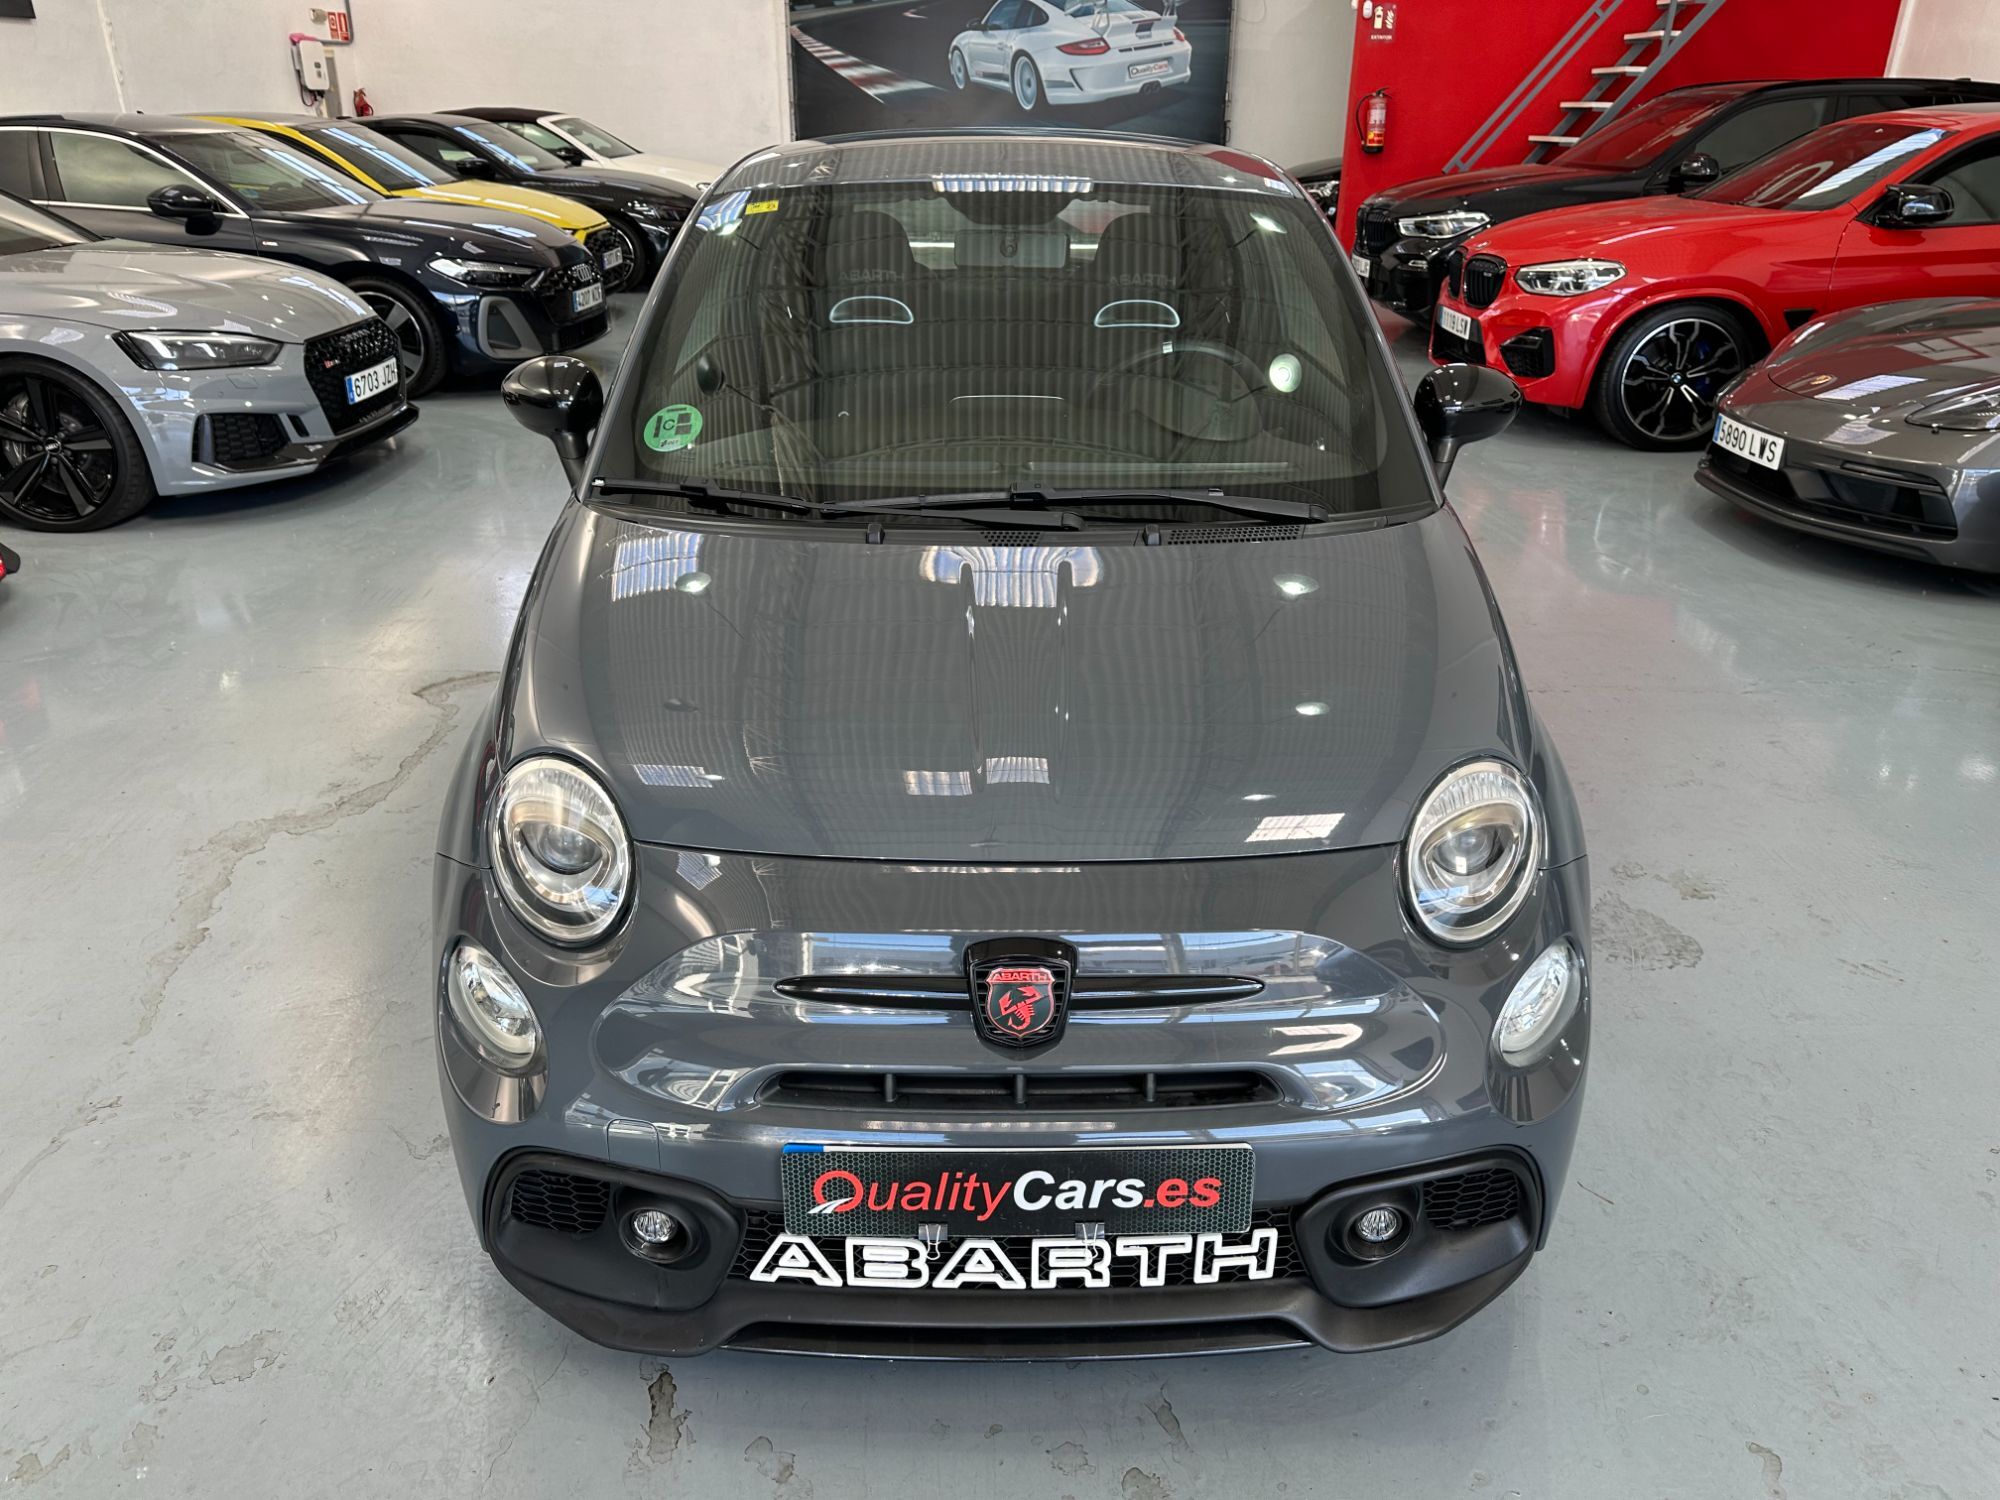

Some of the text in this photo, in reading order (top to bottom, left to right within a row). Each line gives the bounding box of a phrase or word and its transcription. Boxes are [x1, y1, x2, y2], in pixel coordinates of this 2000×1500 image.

[839, 268, 905, 282] ABARTH
[353, 361, 398, 398] 6703 JZH
[1719, 420, 1777, 463] 5890 LWS
[993, 972, 1047, 981] ABARTH
[808, 1168, 1221, 1221] QualityCars.es
[749, 1228, 1278, 1289] ABARTH
